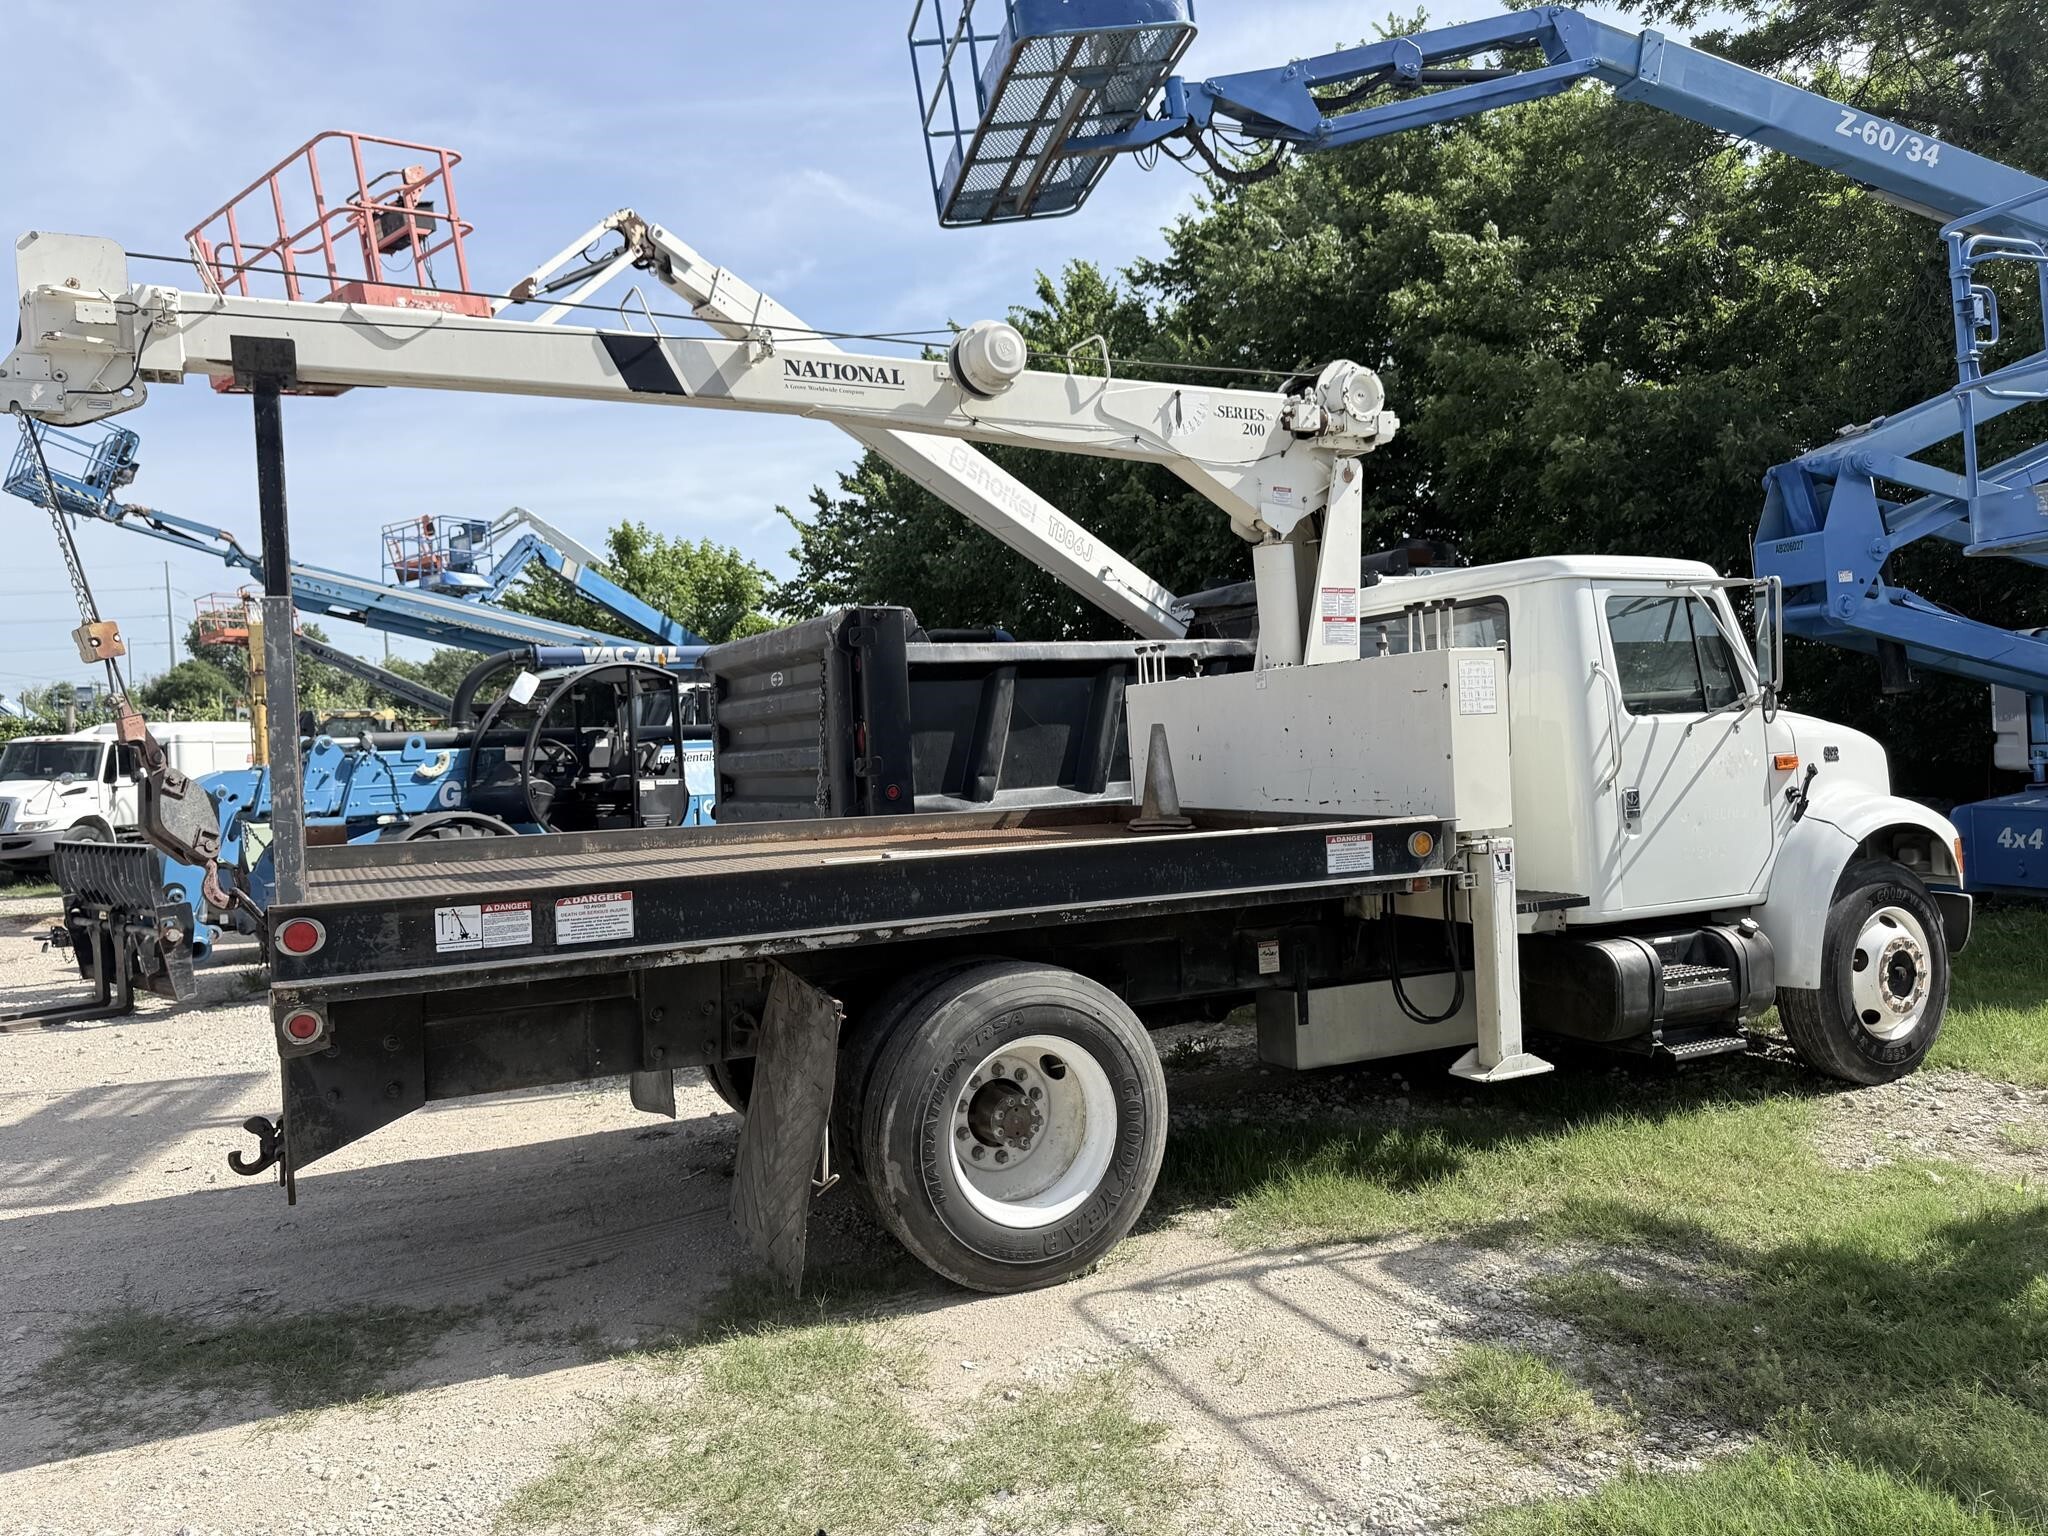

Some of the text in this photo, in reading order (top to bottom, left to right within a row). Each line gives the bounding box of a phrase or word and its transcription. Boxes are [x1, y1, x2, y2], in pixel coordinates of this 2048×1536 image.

[1835, 109, 1940, 168] Z-60/34
[783, 359, 905, 386] NATIONAL
[808, 385, 838, 394] Worldwide
[839, 388, 865, 396] Company
[1217, 405, 1265, 421] SERIES
[1242, 423, 1265, 436] 200
[1048, 515, 1094, 562] TB86J
[582, 646, 681, 664] VACALL
[438, 780, 462, 808] G
[1336, 834, 1366, 843] DANGER
[1997, 827, 2044, 850] 4x4
[493, 902, 528, 911] DANGER
[573, 893, 623, 904] DANGER
